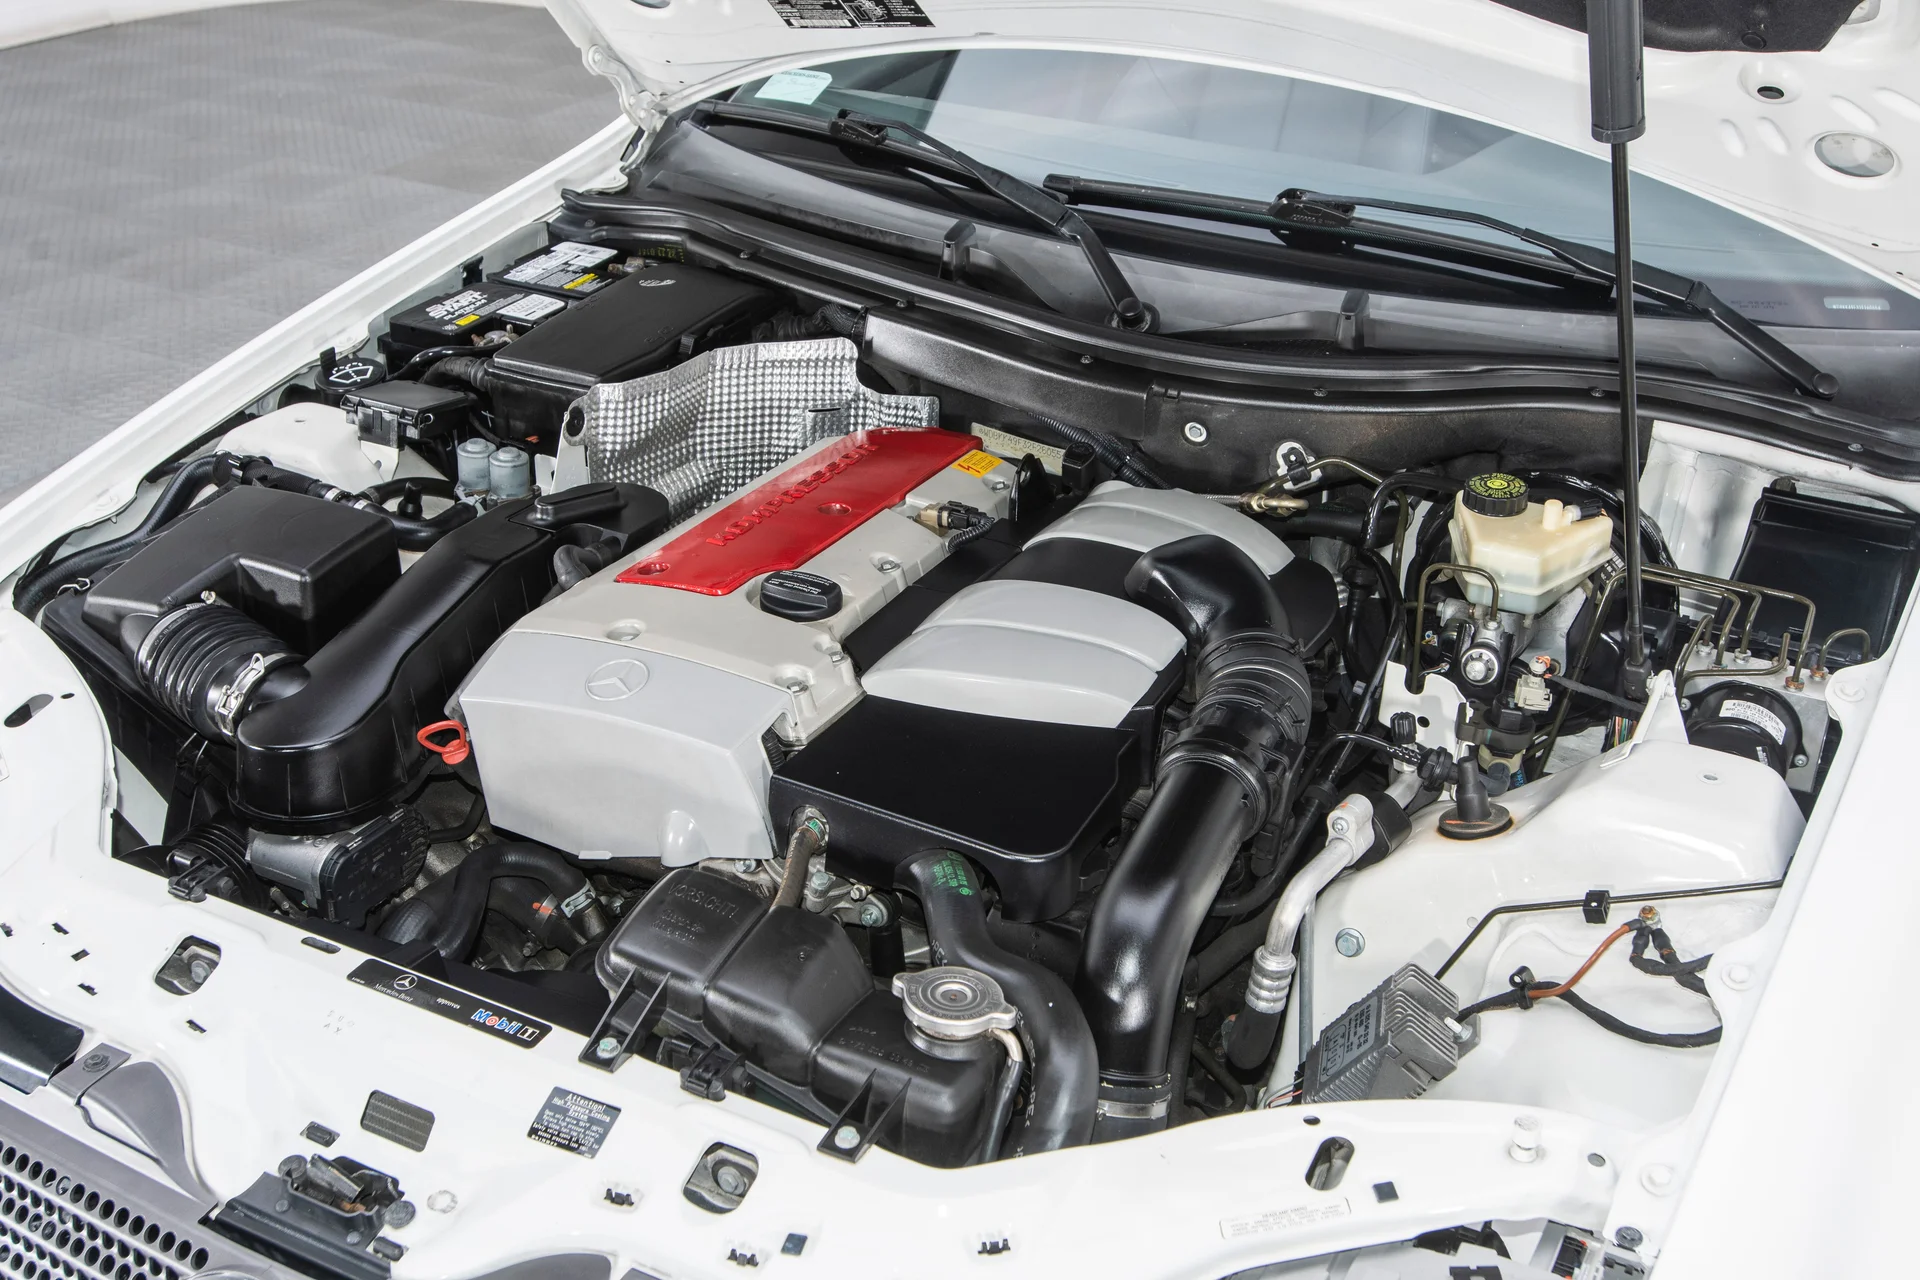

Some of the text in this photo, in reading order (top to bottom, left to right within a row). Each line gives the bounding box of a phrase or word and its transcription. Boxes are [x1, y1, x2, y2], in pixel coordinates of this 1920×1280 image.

[705, 443, 880, 547] KOMPRESSOR
[668, 882, 739, 919] VORSICHT!
[470, 1008, 522, 1035] Mobil
[551, 1096, 565, 1106] High
[565, 1100, 590, 1115] Pressure
[565, 1093, 606, 1112] Attention!
